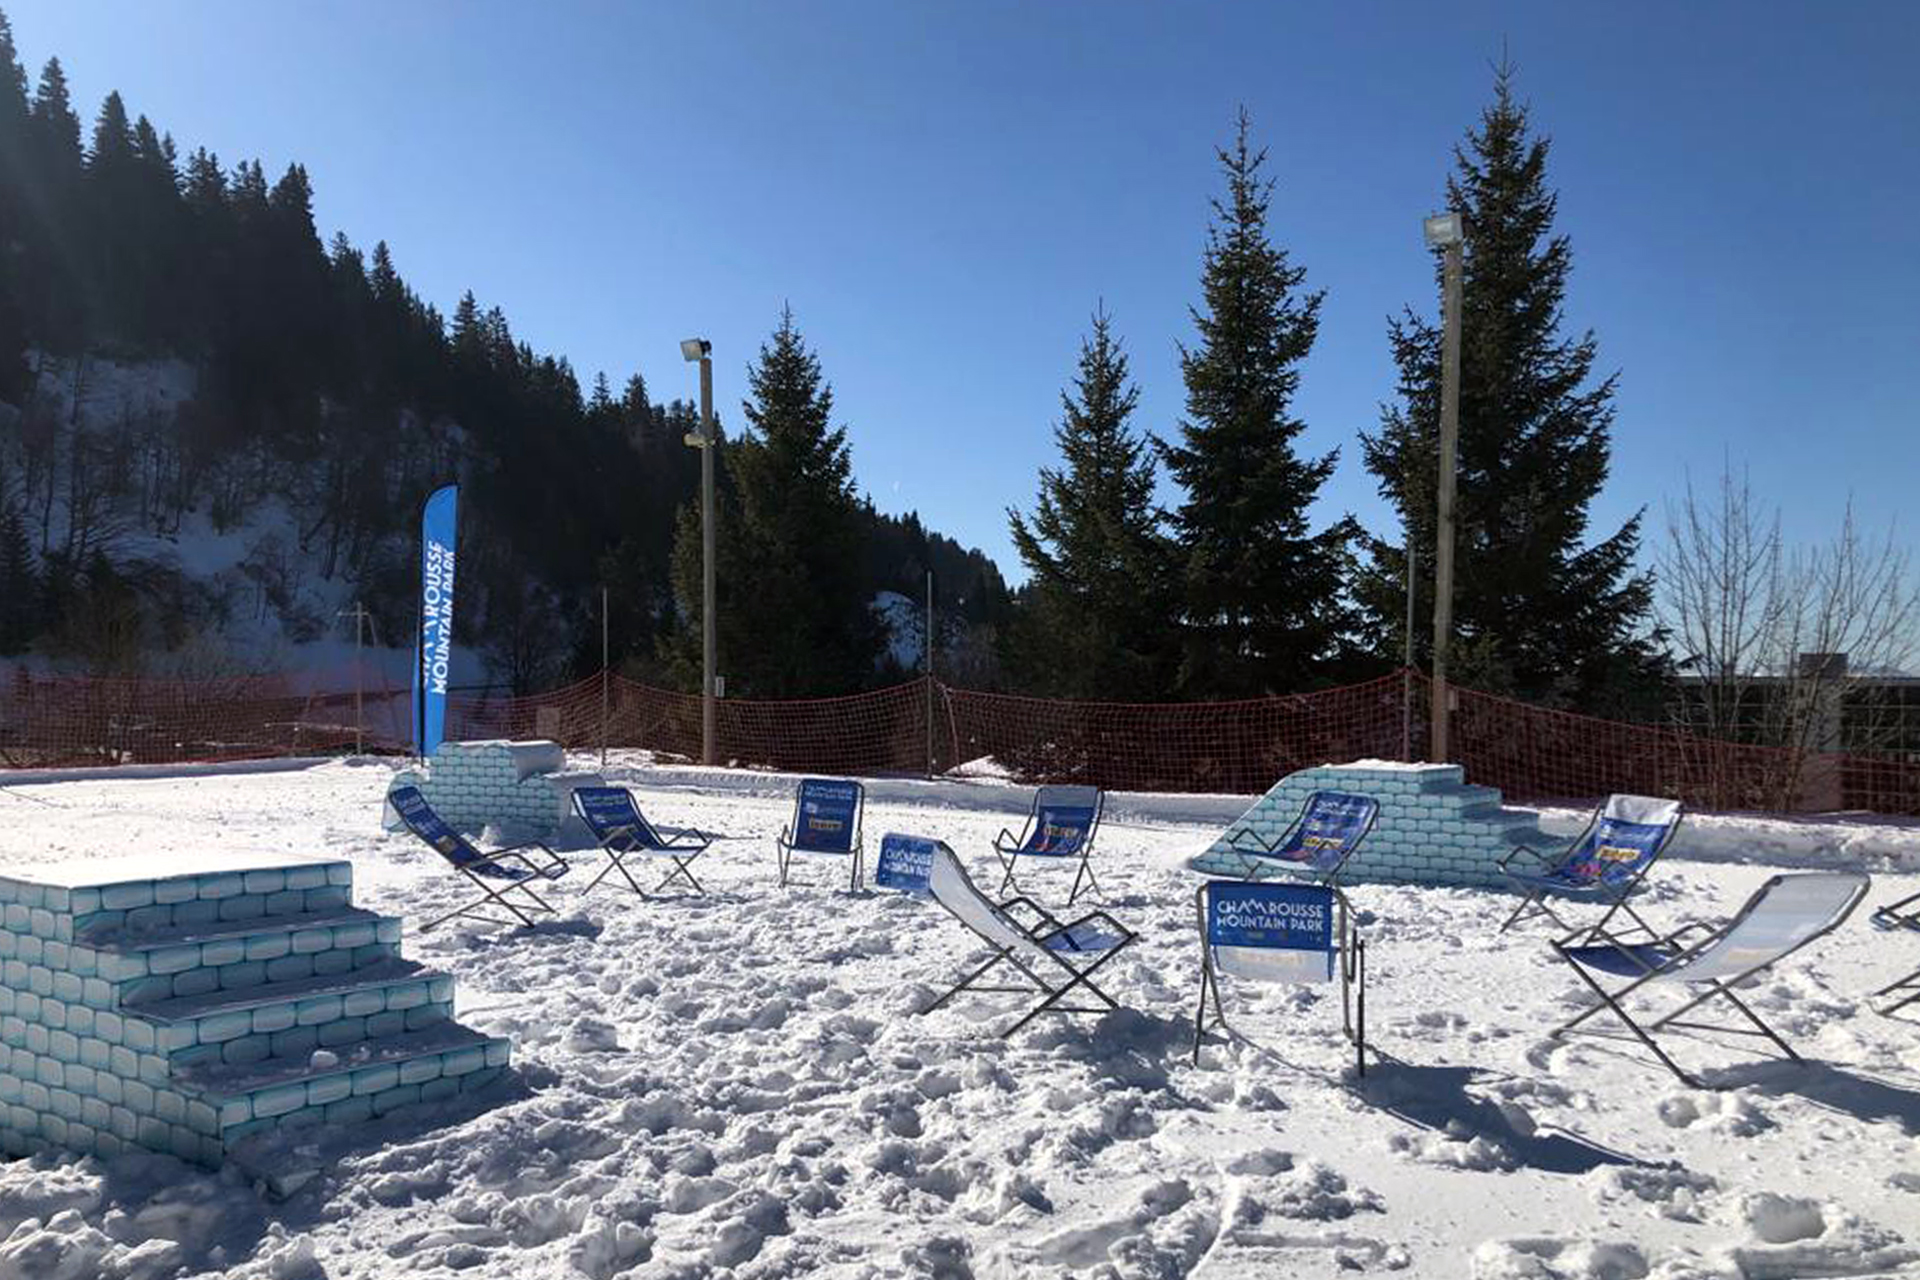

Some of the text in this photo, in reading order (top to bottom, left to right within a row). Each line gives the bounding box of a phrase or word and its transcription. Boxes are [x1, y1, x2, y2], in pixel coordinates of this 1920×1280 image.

[431, 597, 453, 694] MOUNTAIN
[1217, 915, 1323, 931] MOUNTAIN PARK
